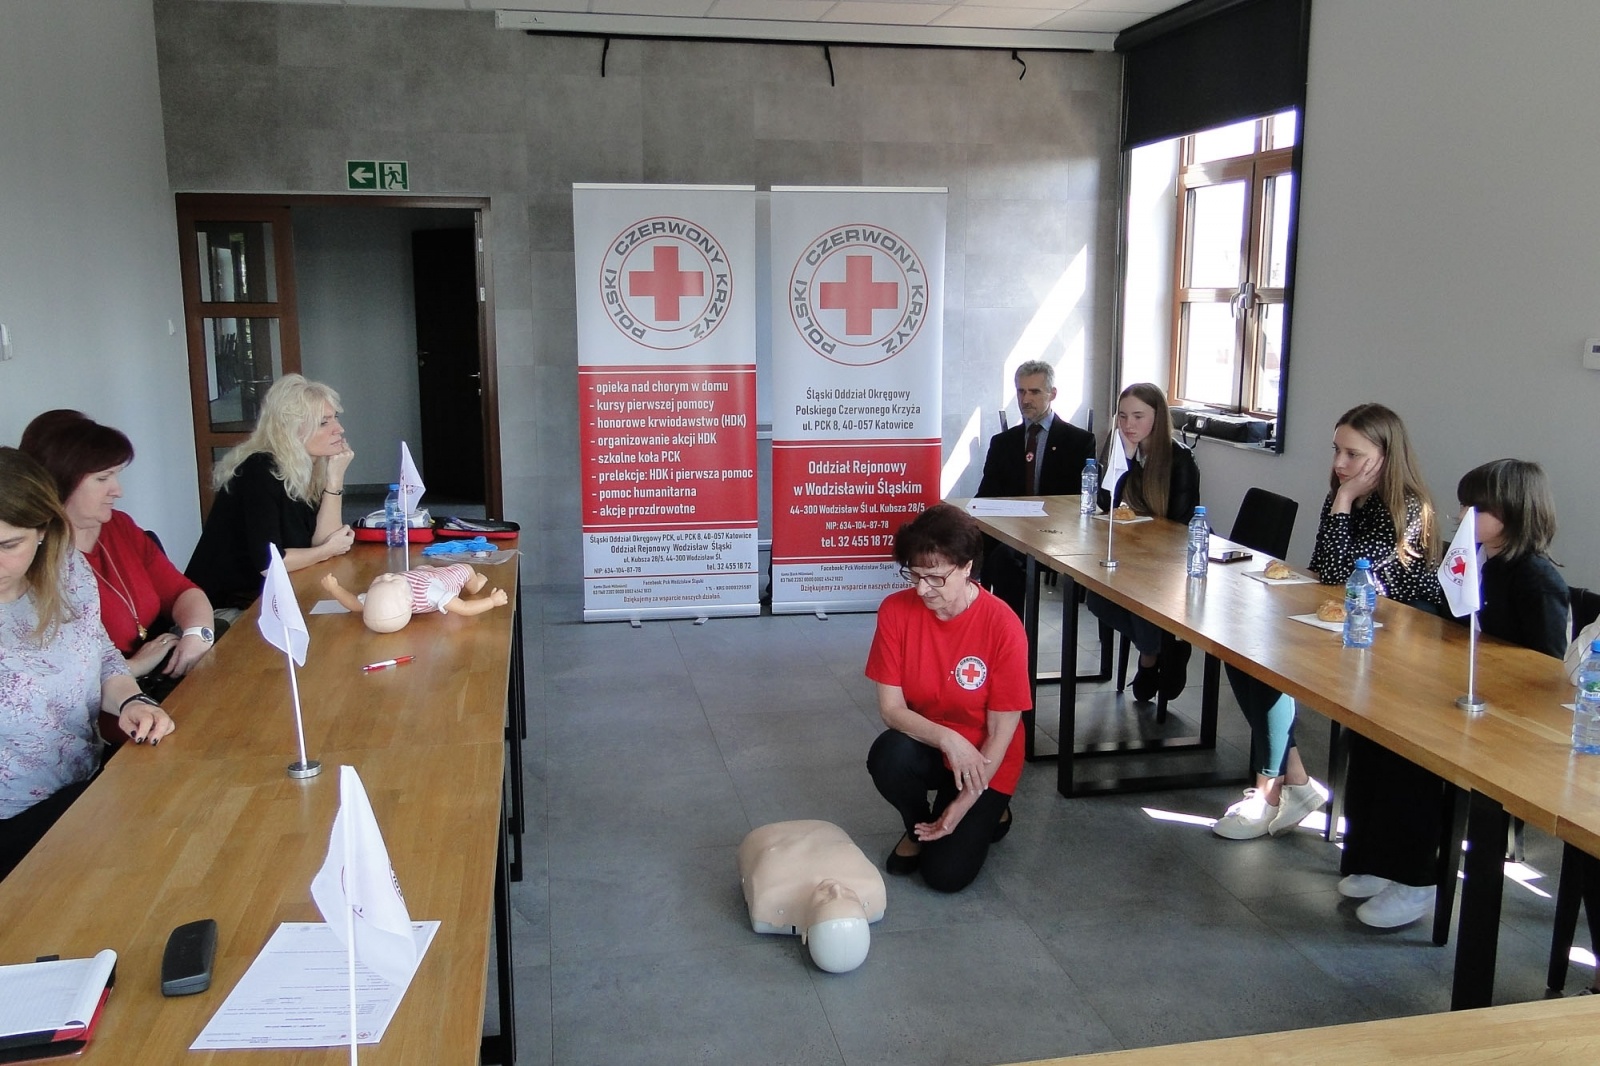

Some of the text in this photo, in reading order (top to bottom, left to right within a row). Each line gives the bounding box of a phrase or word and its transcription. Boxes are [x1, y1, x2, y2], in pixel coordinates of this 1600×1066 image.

[605, 221, 728, 339] POLSKI CZERWONY KRZYŻ
[794, 229, 924, 354] POLSKI CZERWONY KRZYŻ
[596, 381, 629, 395] opieka
[631, 381, 650, 392] nad
[652, 380, 688, 394] chorym
[691, 383, 700, 392] w
[702, 380, 728, 392] domu
[806, 387, 910, 402] Śląski Oddział Okręgowy
[597, 399, 624, 413] kursy
[627, 399, 674, 412] pierwszej
[677, 400, 714, 412] pomocy
[795, 404, 921, 417] Polskiego Czerwonego Krzyża
[597, 417, 645, 428] honorowe
[648, 415, 719, 428] krwiodawstwo
[721, 414, 747, 428] (HDK)
[802, 419, 914, 431] ul. PCK 8, 40-057 Katowice
[598, 434, 670, 449] organizowanie
[672, 433, 696, 447] akcji
[698, 432, 717, 444] HDK
[598, 452, 636, 464] szkolne
[638, 451, 659, 462] koła
[661, 450, 681, 462] PCK
[808, 460, 907, 476] Oddział Rejonowy
[599, 470, 648, 484] prelekcje:
[649, 468, 669, 480] HDK
[670, 468, 674, 480] i
[676, 468, 720, 482] pierwsza
[722, 469, 753, 481] pomoc
[599, 489, 632, 502] pomoc
[634, 486, 697, 498] humanitarna
[793, 477, 922, 497] w Wodzisławiu Śląskim
[600, 504, 626, 518] akcje
[628, 504, 696, 518] prozdrowotne
[790, 505, 818, 514] 44-300
[819, 503, 858, 514] Wodzisław
[869, 503, 878, 513] ul.
[880, 503, 906, 513] Kubsza
[826, 520, 889, 530] NIP: 634-104-87-78
[589, 534, 608, 545] Śląski
[703, 532, 724, 540] 40-057
[821, 535, 894, 548] tel. 32 455 18 72
[611, 540, 732, 554] Oddział Rejonowy Wodzisław Śląski
